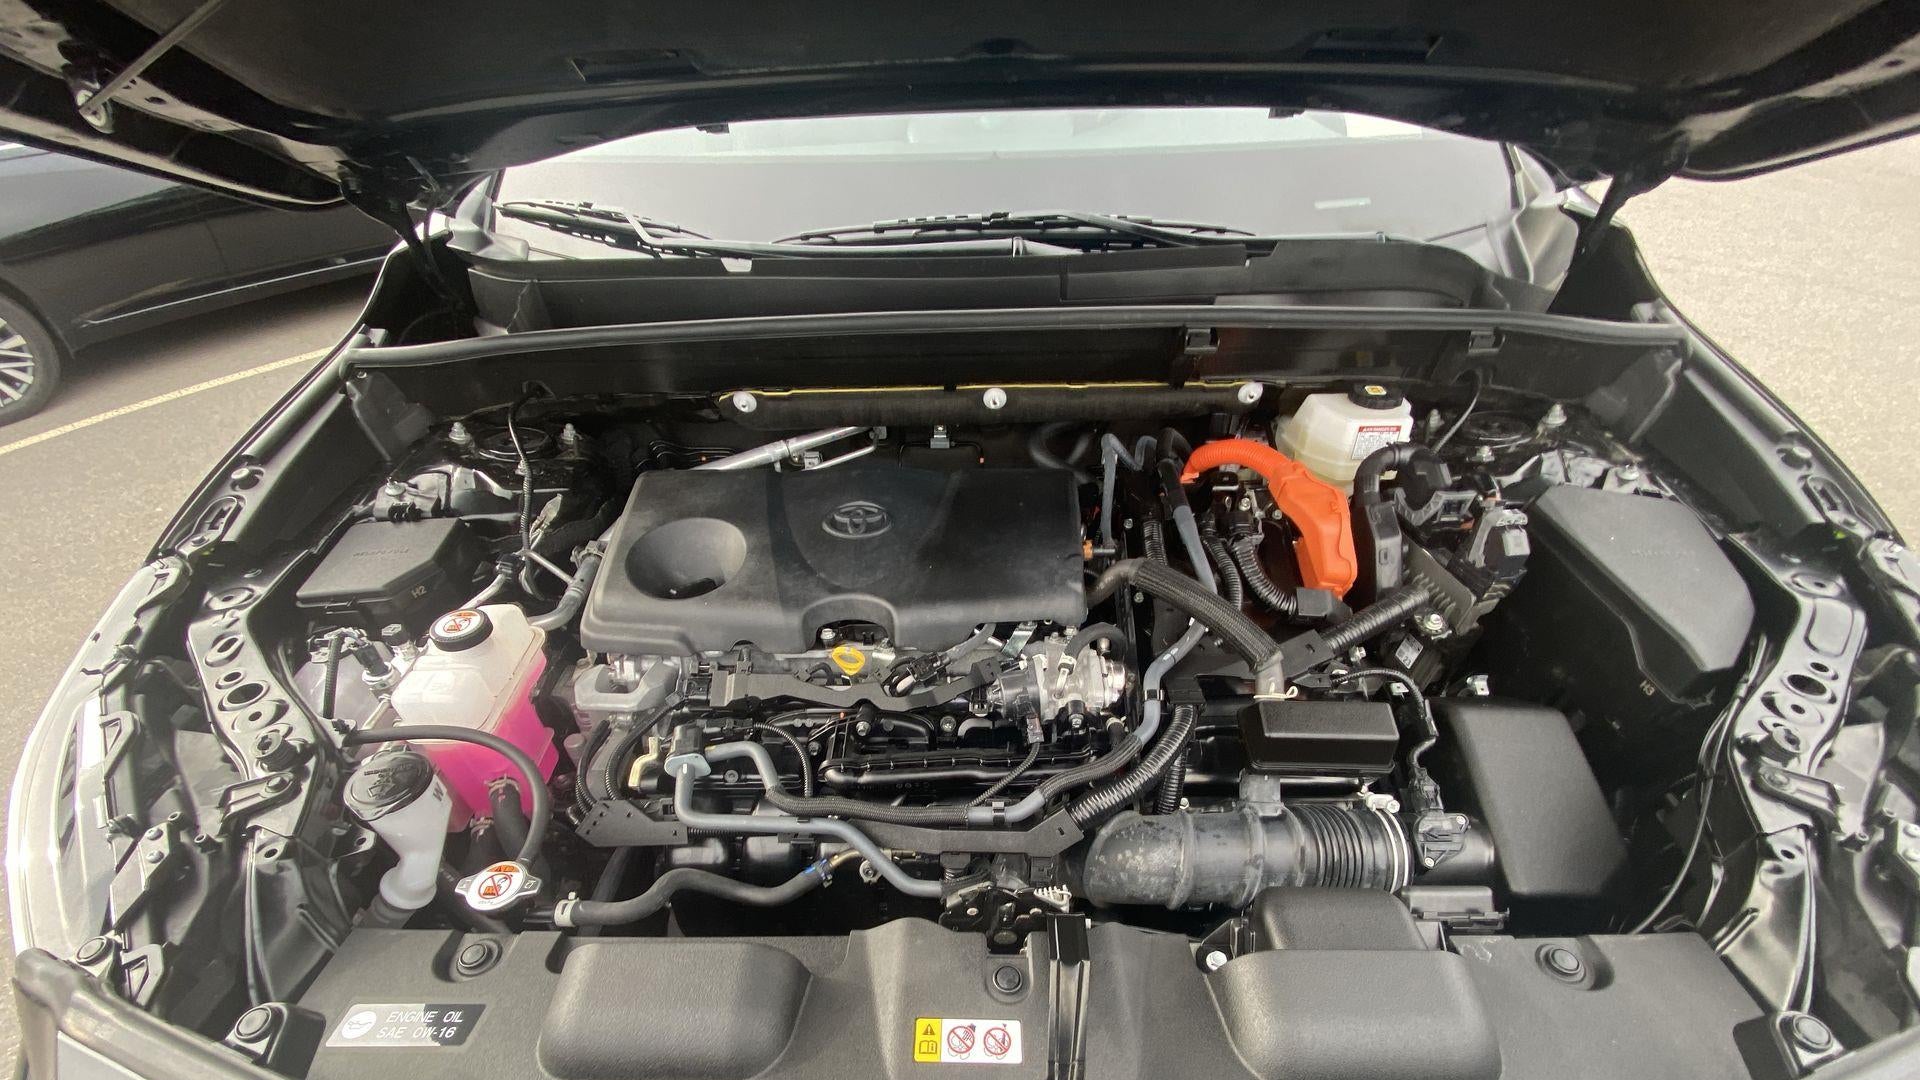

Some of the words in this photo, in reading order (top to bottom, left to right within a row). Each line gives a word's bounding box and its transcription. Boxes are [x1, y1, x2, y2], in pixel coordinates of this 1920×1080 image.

[411, 585, 427, 599] H2
[386, 1011, 438, 1023] ENGINE
[442, 1011, 463, 1023] OIL
[376, 1027, 408, 1039] SAE
